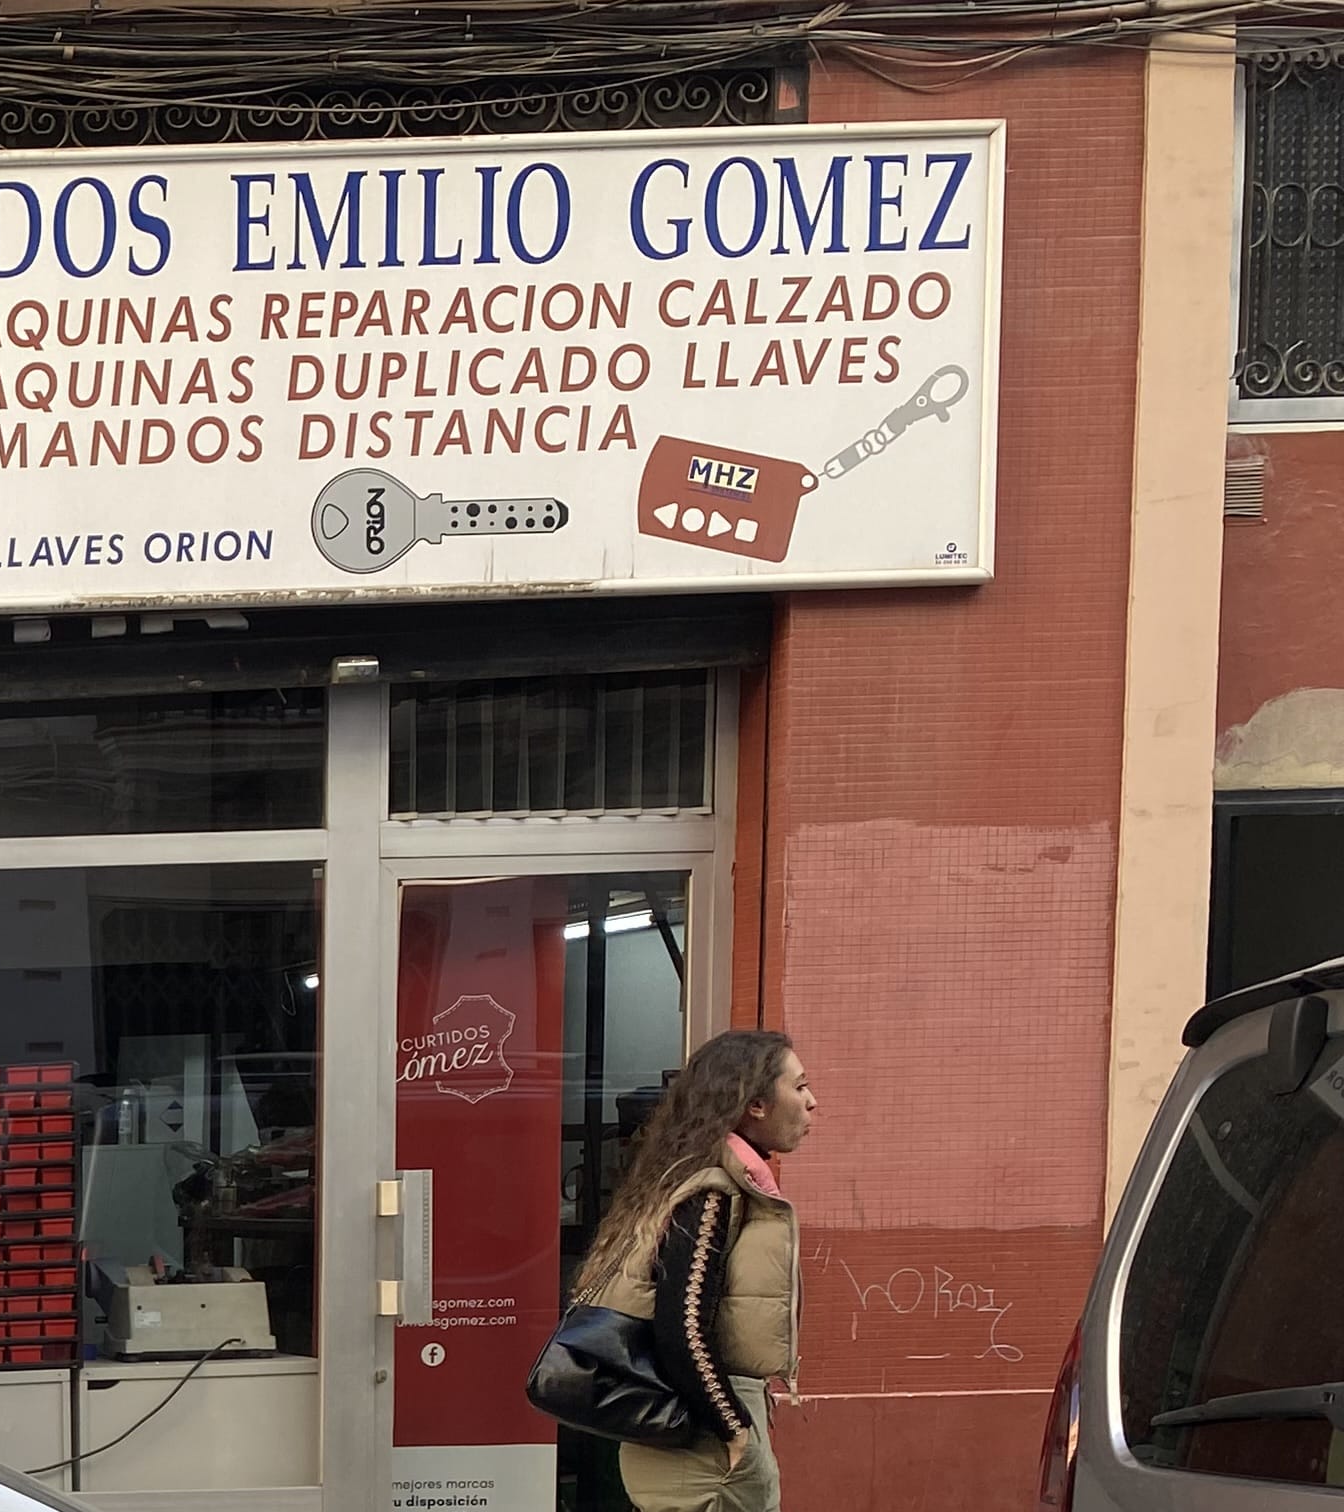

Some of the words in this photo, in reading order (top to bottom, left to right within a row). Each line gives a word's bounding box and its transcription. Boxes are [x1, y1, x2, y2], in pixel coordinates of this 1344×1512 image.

[230, 162, 571, 273] EMILIO
[629, 152, 973, 261] GOMEZ
[260, 281, 632, 340] REPARACION
[658, 271, 952, 328] CALZADO
[287, 343, 651, 402] DUPLICADO
[682, 335, 902, 389] LLAVES
[298, 403, 637, 461] DISTANCIA
[689, 458, 756, 490] MHZ
[143, 529, 273, 564] ORION
[400, 1024, 491, 1052] CURTIDOS
[396, 1041, 494, 1083] ómez
[431, 1297, 516, 1312] sgomez.com
[392, 1479, 442, 1493] mejores
[445, 1479, 495, 1490] marcas
[392, 1497, 402, 1508] u
[405, 1494, 488, 1510] disposición
